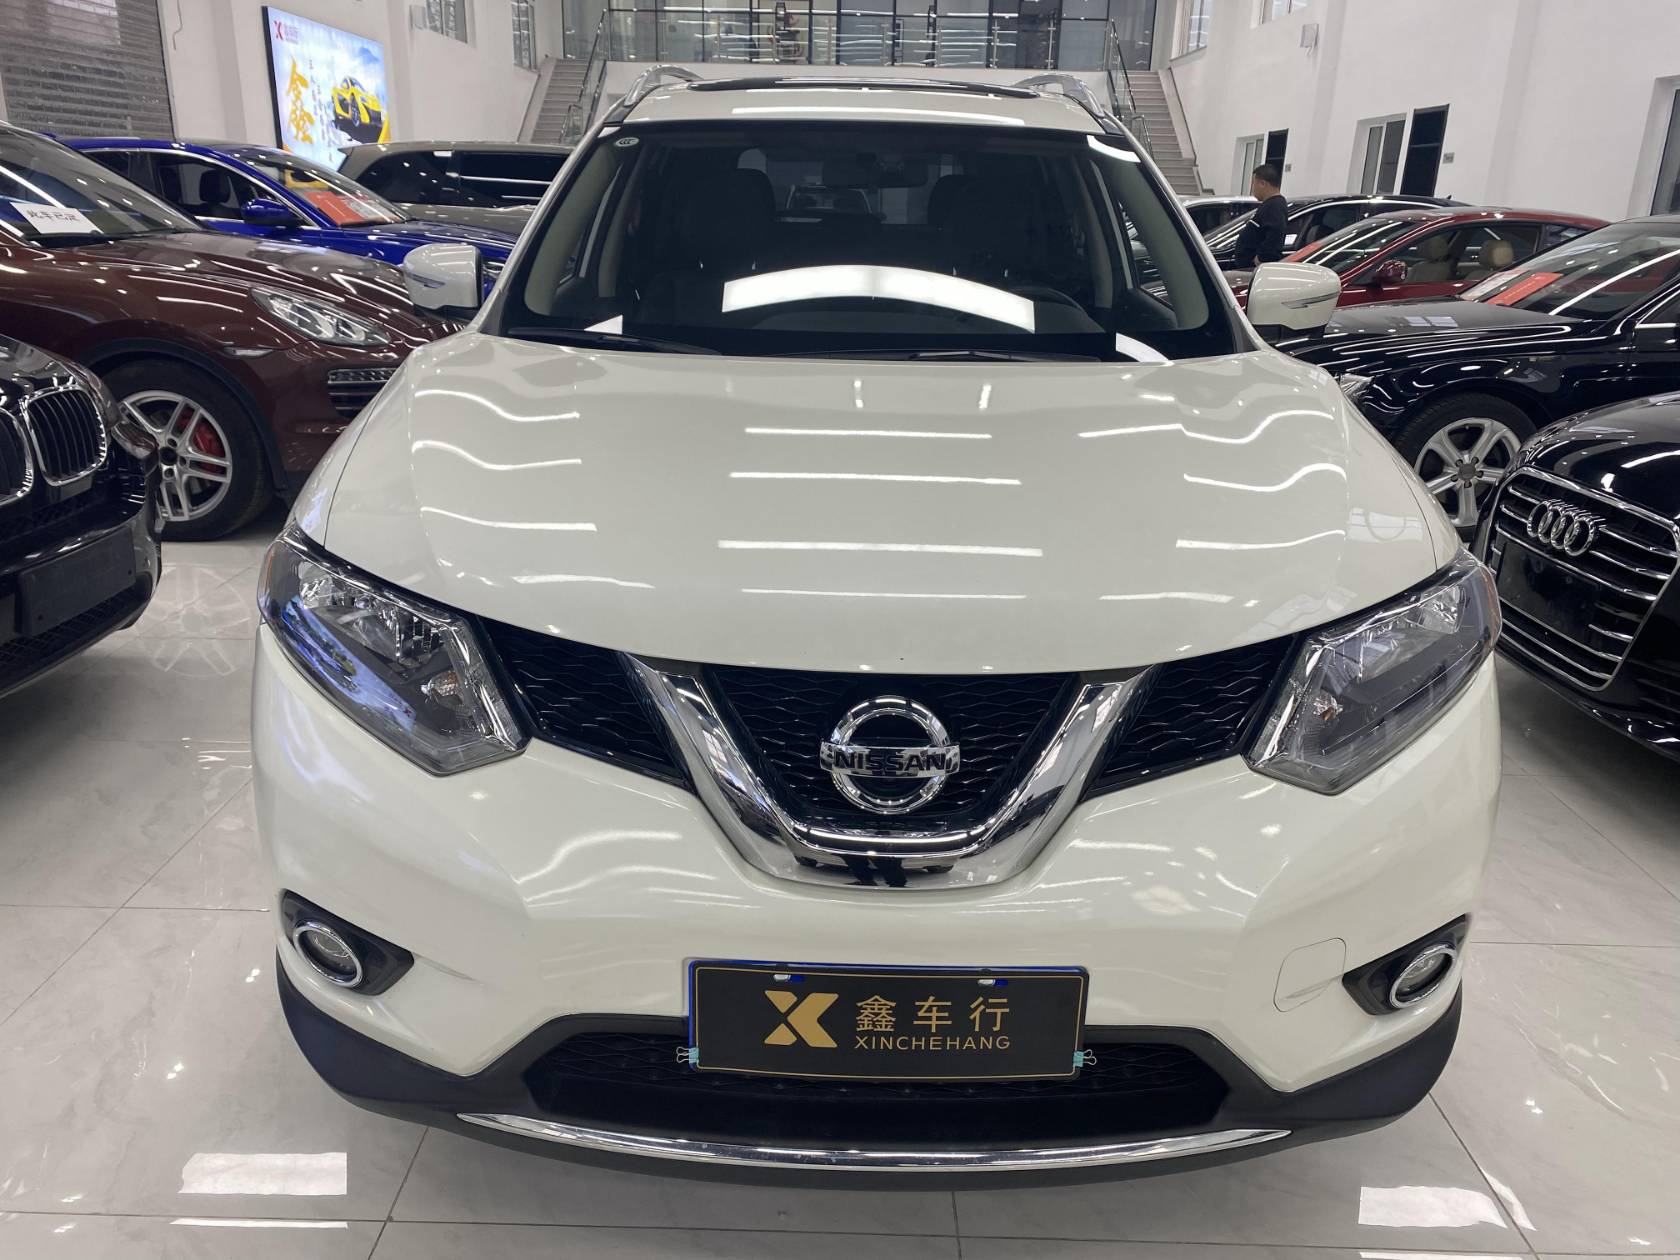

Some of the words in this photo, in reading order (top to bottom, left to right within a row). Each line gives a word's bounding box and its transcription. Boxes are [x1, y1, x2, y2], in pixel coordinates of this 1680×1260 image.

[833, 752, 947, 772] NISSAN
[856, 995, 1010, 1032] 鑫车行
[855, 1035, 1010, 1050] XINCHEHANG
